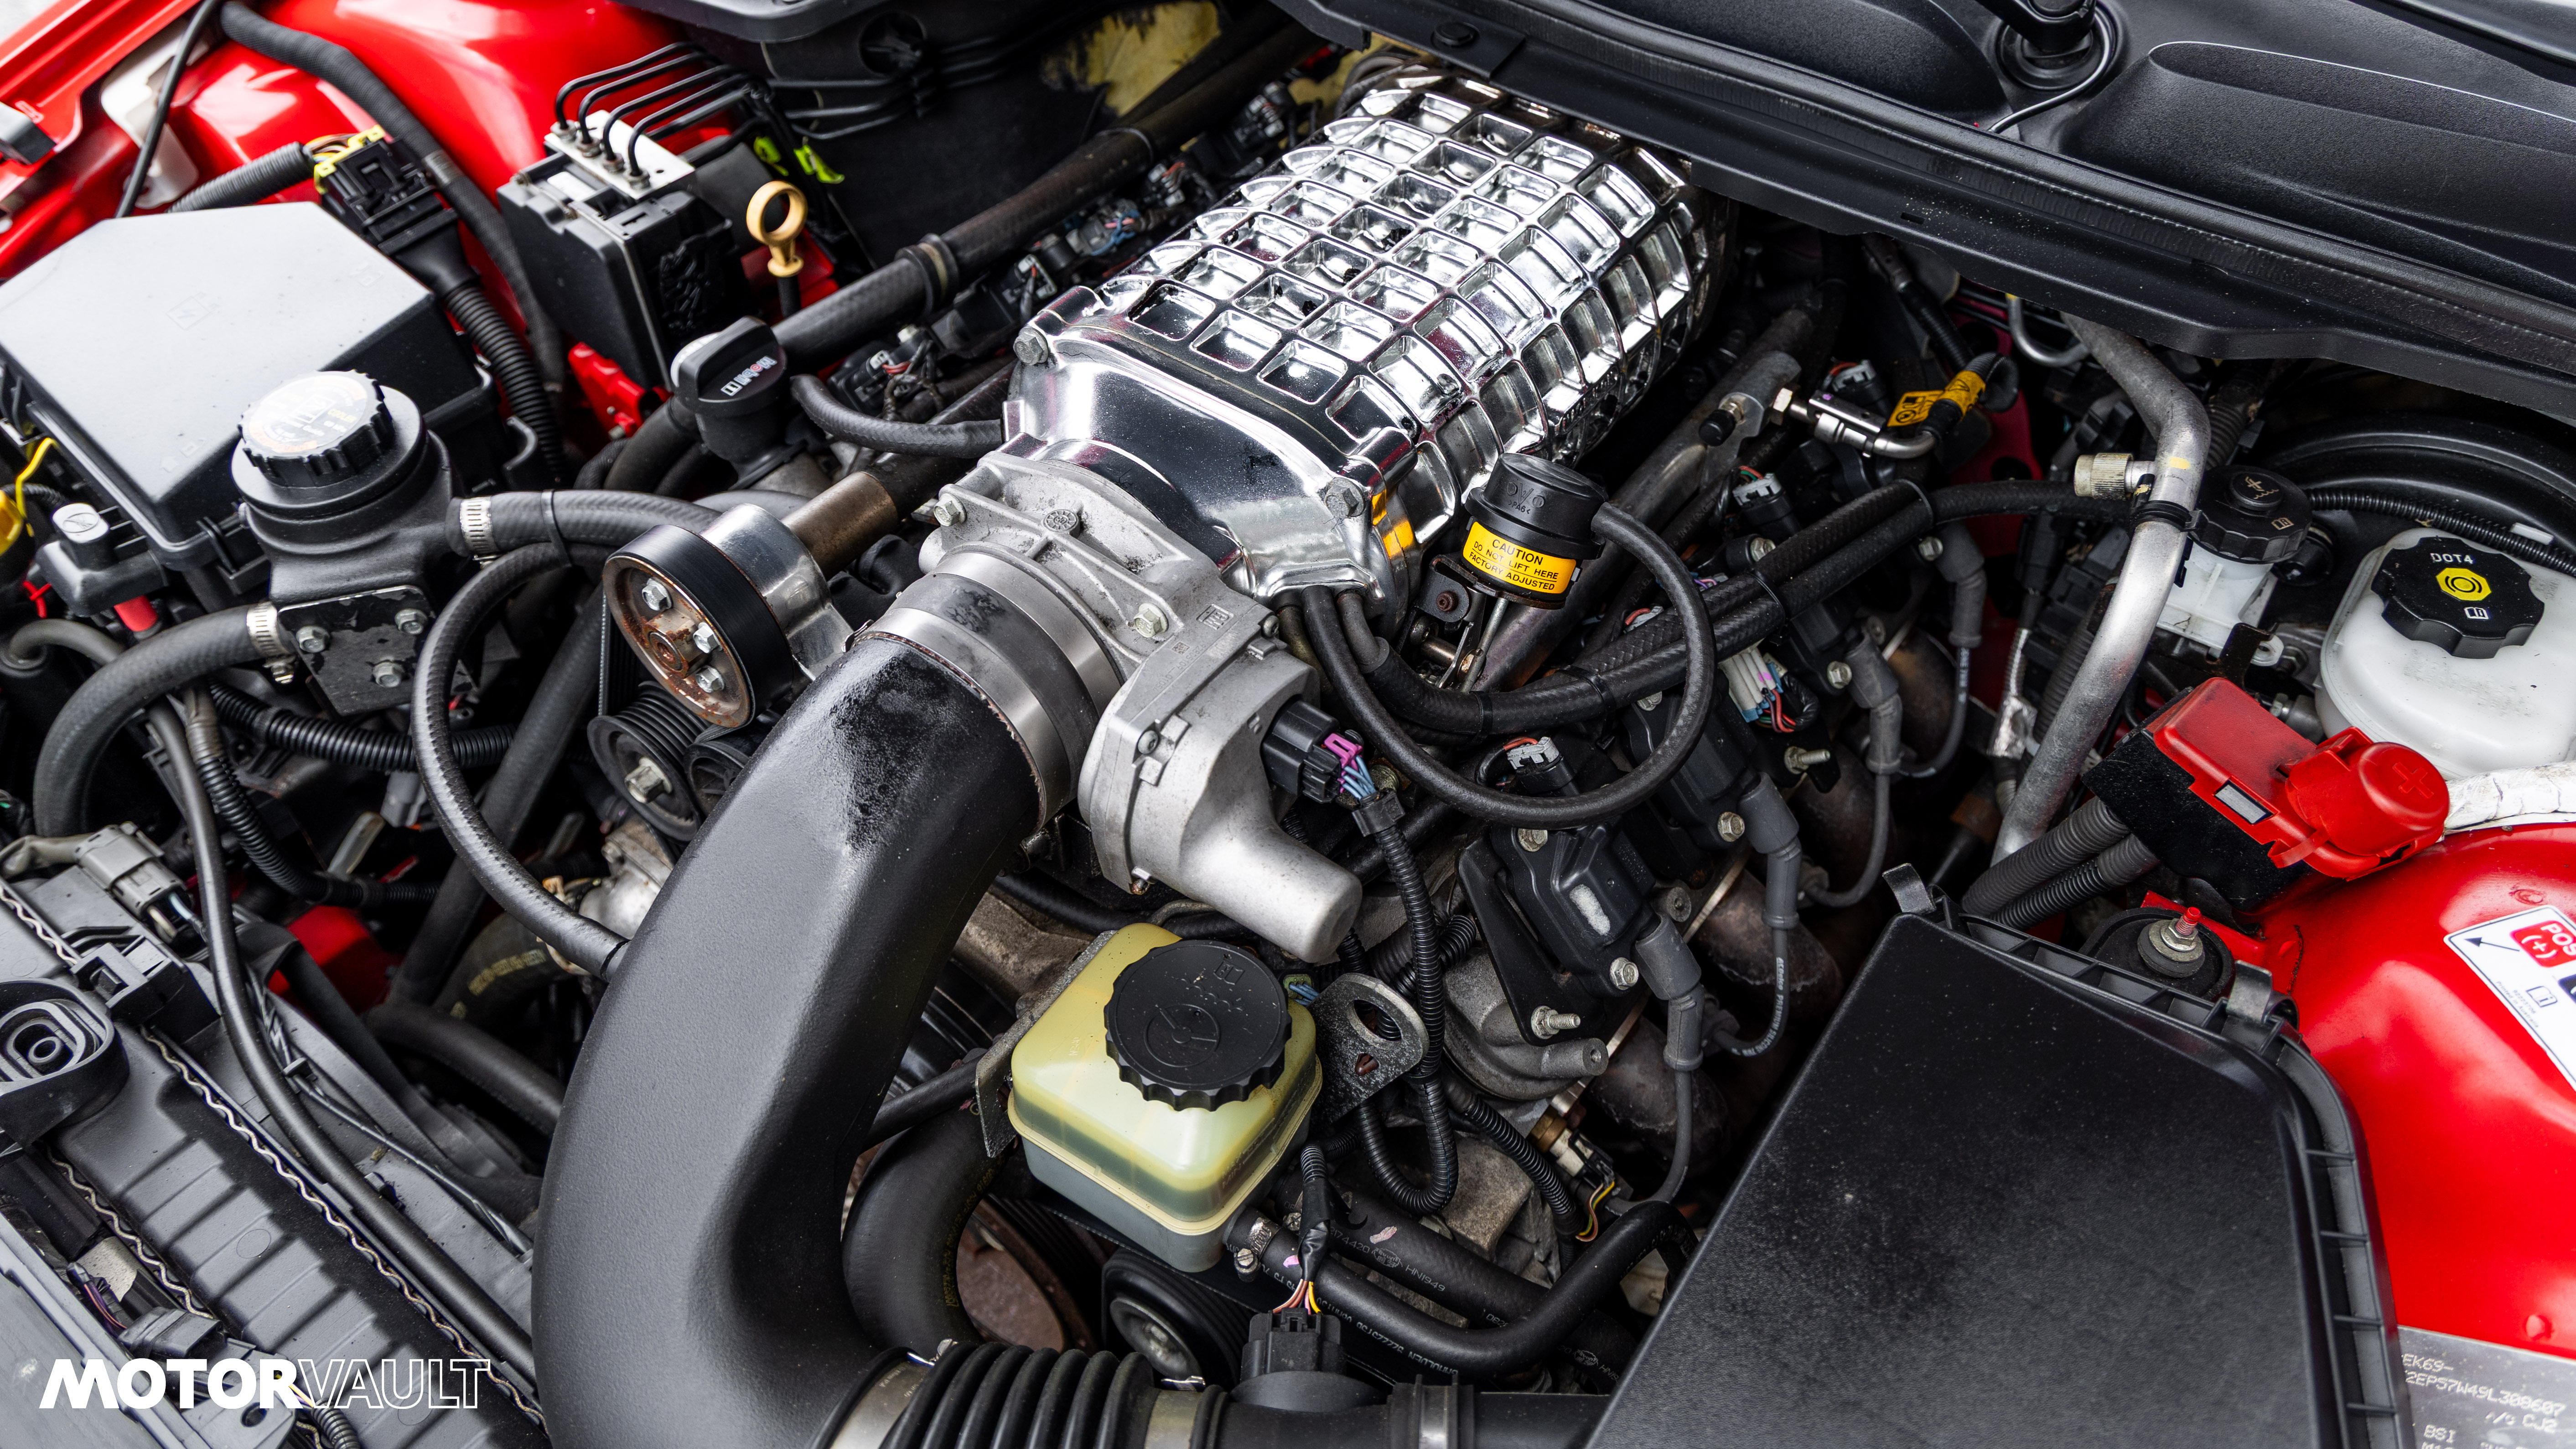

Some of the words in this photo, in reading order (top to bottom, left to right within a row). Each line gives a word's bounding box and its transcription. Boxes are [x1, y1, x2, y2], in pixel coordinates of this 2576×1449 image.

[733, 356, 777, 386] Mobil
[1474, 541, 1483, 551] DO
[1486, 549, 1504, 563] NOT
[1509, 560, 1530, 572] LIFT
[1534, 568, 1559, 580] HERE
[1493, 539, 1544, 565] CAUTION
[1469, 551, 1503, 576] FACTORY
[1505, 572, 1555, 590] ADJUSTED
[1776, 957, 1784, 990] ACDelco
[1771, 994, 1784, 1030] PREMIUM
[1405, 1264, 1446, 1293] HN1949
[1599, 1363, 1620, 1381] HN19
[2401, 1353, 2453, 1372] EK69-
